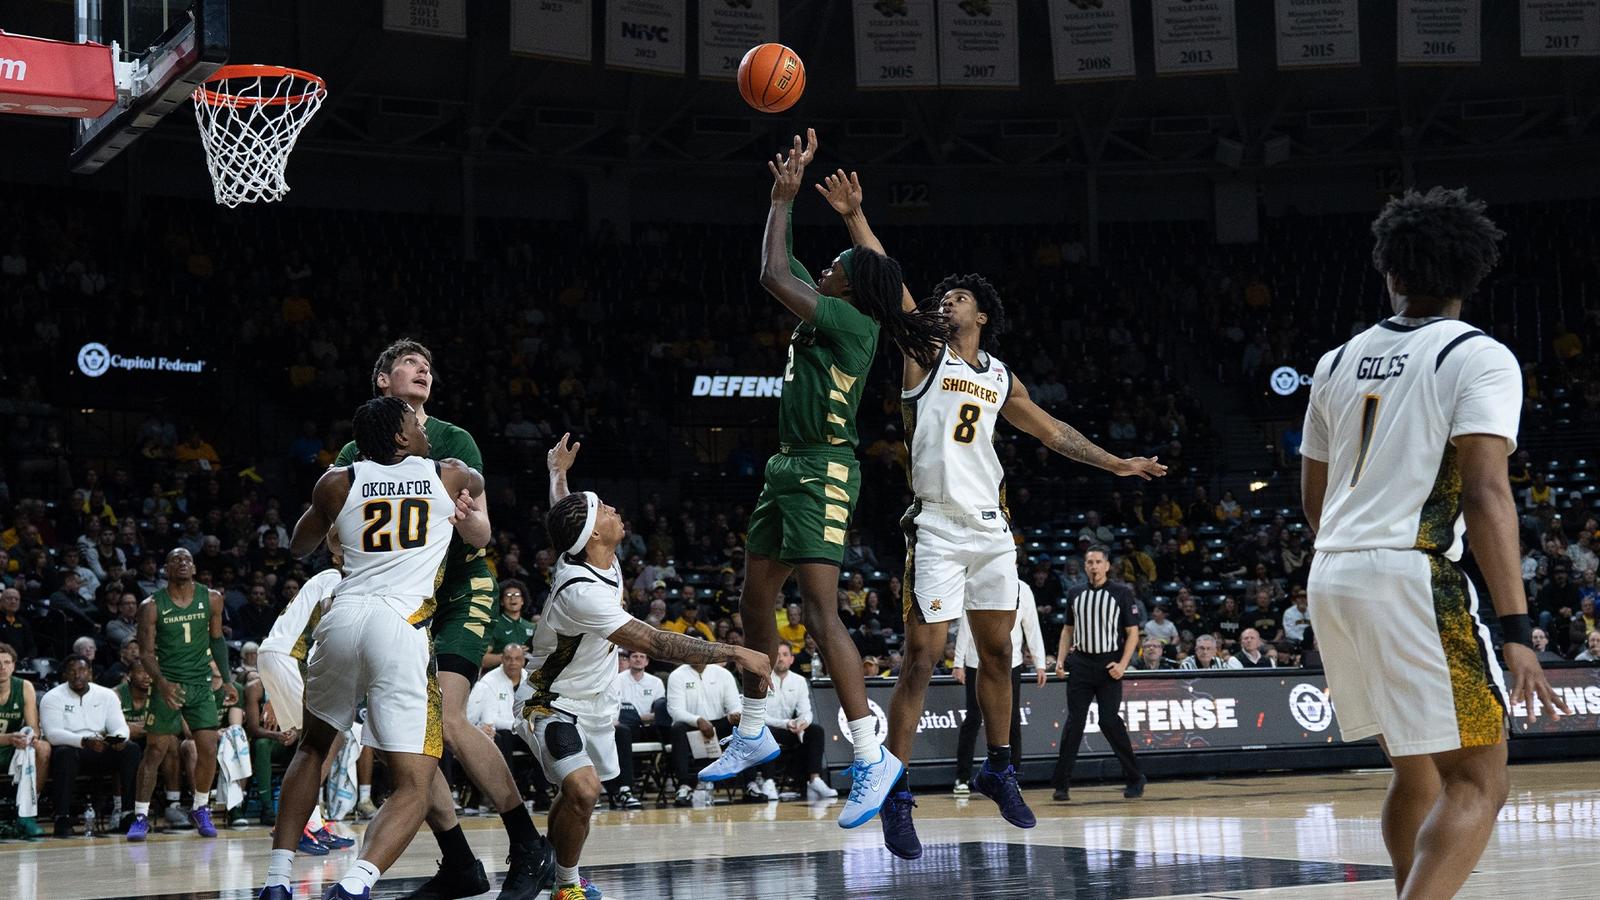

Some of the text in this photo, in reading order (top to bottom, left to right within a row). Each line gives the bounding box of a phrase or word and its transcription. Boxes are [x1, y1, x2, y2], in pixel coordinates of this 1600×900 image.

[1301, 43, 1335, 58] 2015
[1423, 41, 1456, 55] 2016
[1544, 35, 1580, 49] 2017
[722, 56, 740, 70] 20
[1078, 56, 1111, 71] 2008
[1181, 50, 1213, 64] 2013
[777, 56, 798, 90] ELITE
[880, 65, 915, 79] 2005
[963, 64, 996, 78] 2007
[888, 184, 930, 208] 122
[111, 354, 156, 370] Capitol
[1357, 354, 1409, 380] GILES
[691, 375, 783, 398] DEFENS
[942, 377, 998, 404] SHOCKERS
[953, 402, 981, 445] 8
[1350, 393, 1382, 488] 1
[362, 480, 433, 498] OKORAFOR
[362, 498, 430, 552] 20
[163, 612, 206, 624] CHARLOTTE
[182, 622, 192, 643] 1
[1510, 686, 1600, 717] EFENS
[915, 709, 958, 734] pitol
